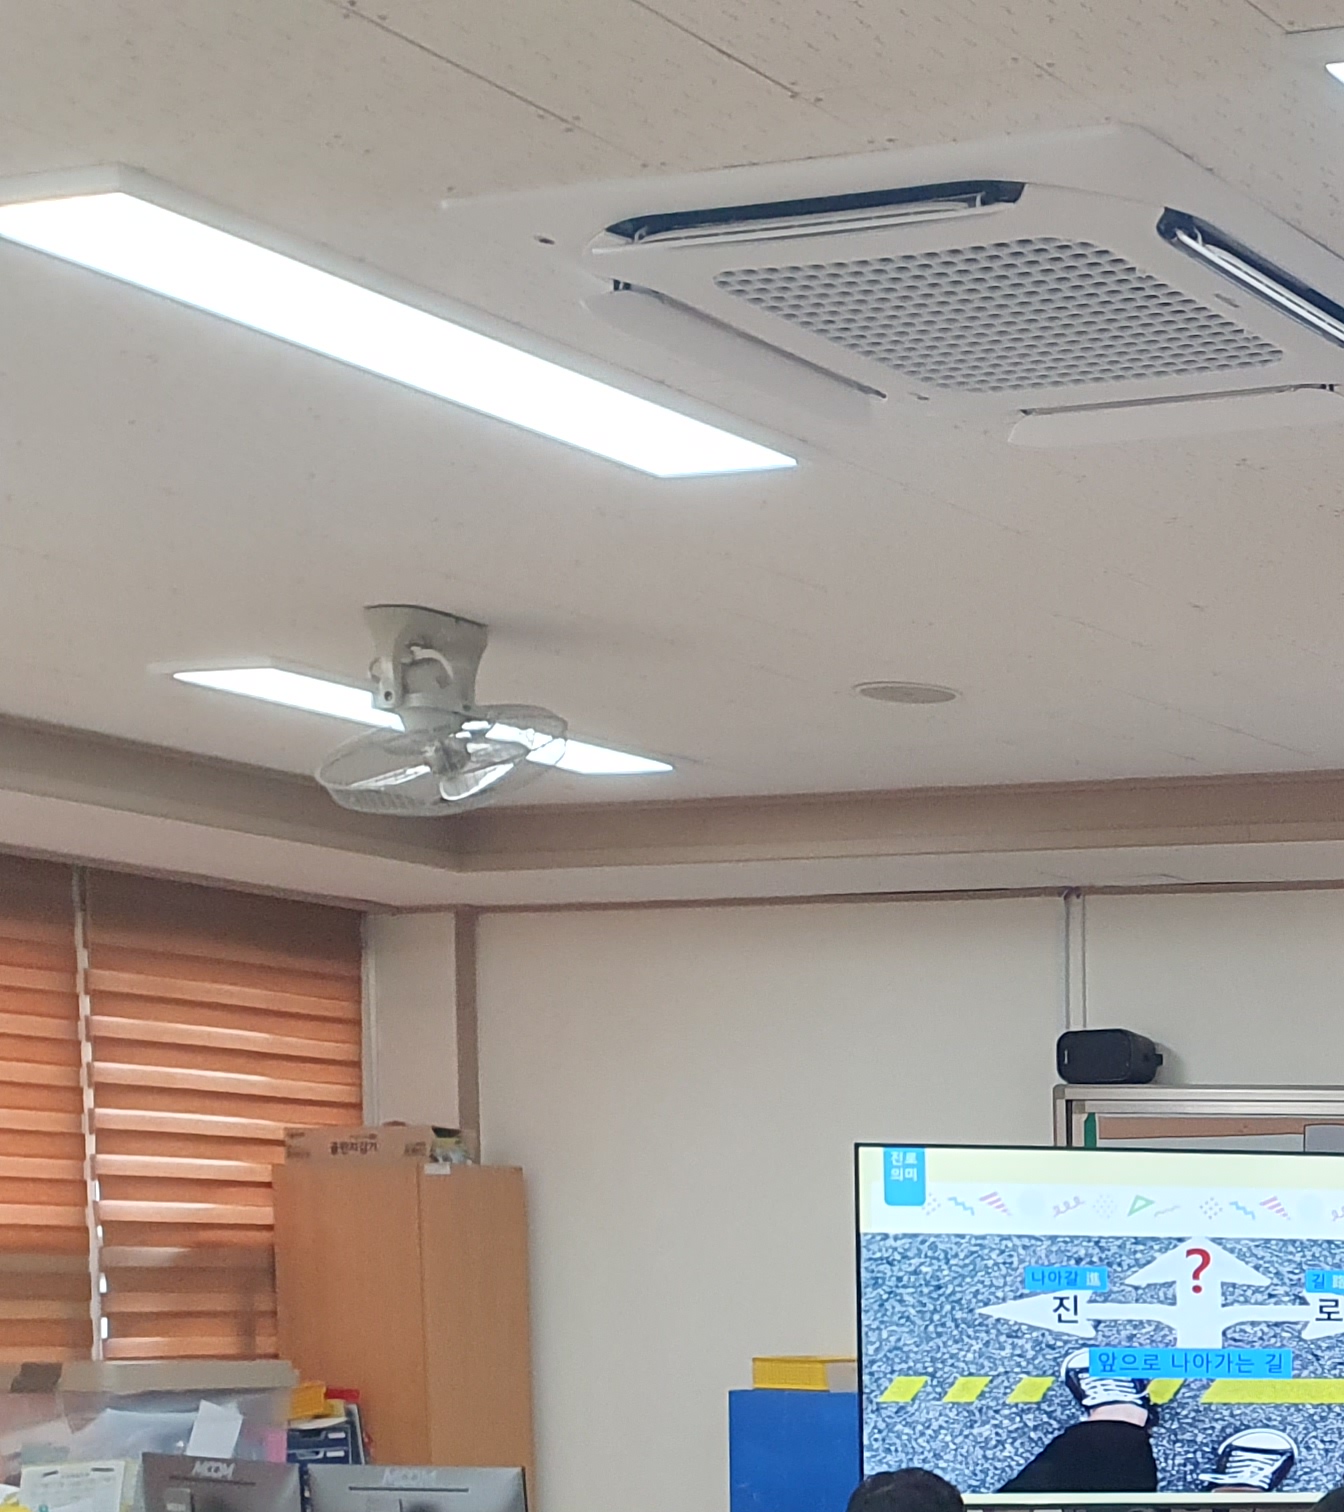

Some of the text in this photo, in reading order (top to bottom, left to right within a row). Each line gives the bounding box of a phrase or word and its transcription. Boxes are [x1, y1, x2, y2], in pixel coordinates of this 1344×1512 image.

[890, 1151, 918, 1166] 진로
[890, 1167, 918, 1182] 의미
[1030, 1271, 1079, 1288] 나아갈
[1186, 1248, 1211, 1294] ?
[1312, 1273, 1326, 1290] 길
[1052, 1294, 1079, 1324] 진
[1315, 1298, 1344, 1323] 로
[1098, 1351, 1284, 1374] 앞으로 나아가는 길
